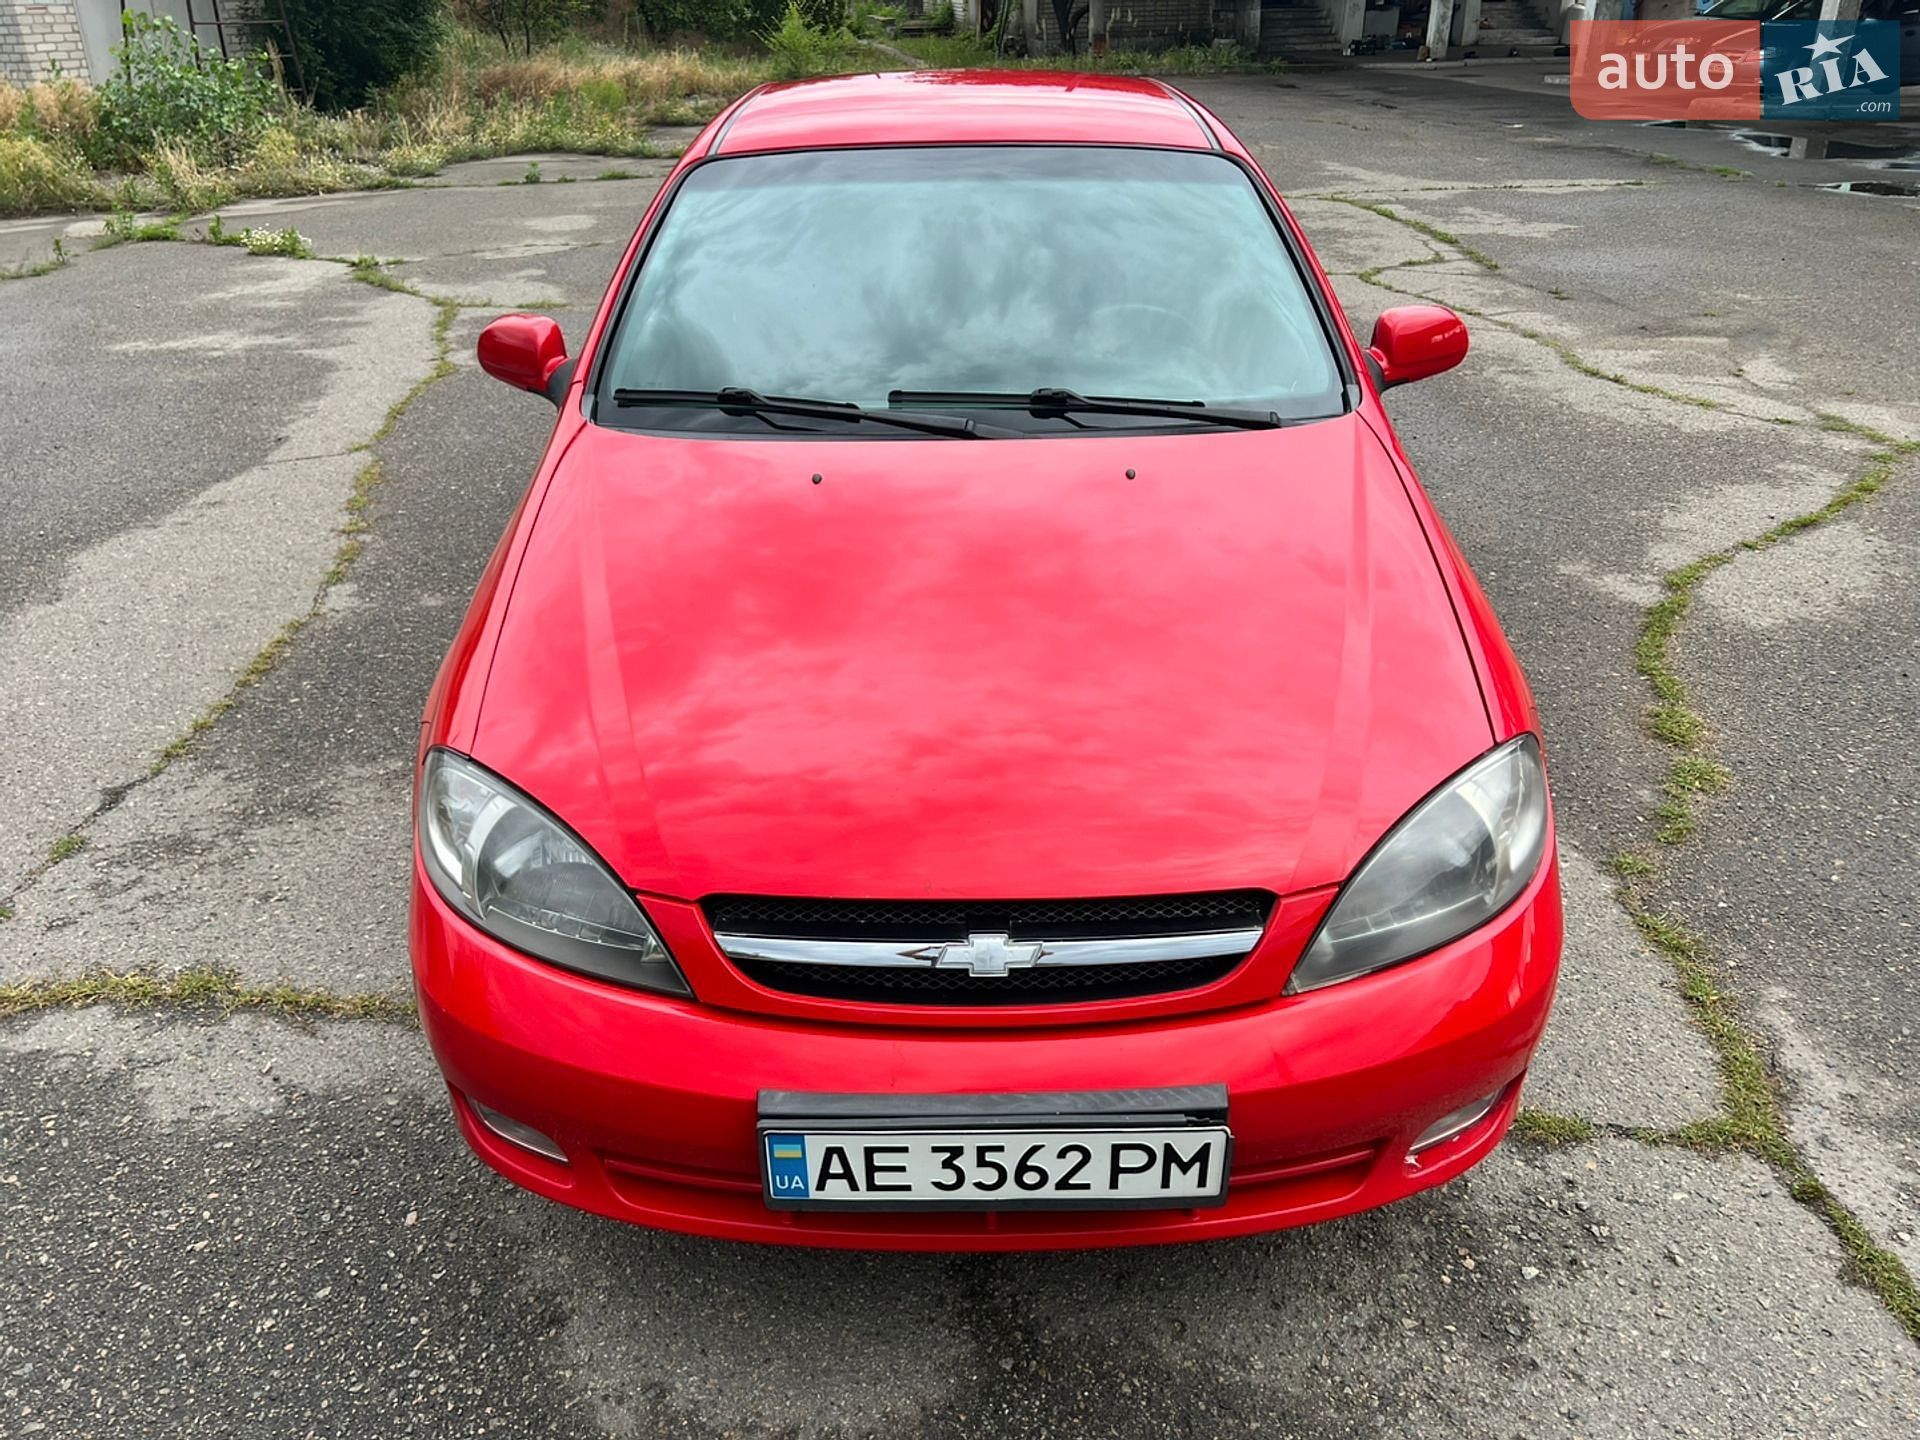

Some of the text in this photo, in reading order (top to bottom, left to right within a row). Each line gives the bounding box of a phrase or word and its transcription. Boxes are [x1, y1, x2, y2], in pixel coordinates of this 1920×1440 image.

[775, 1174, 805, 1191] UA
[815, 1142, 1212, 1192] AE 3562 PM
